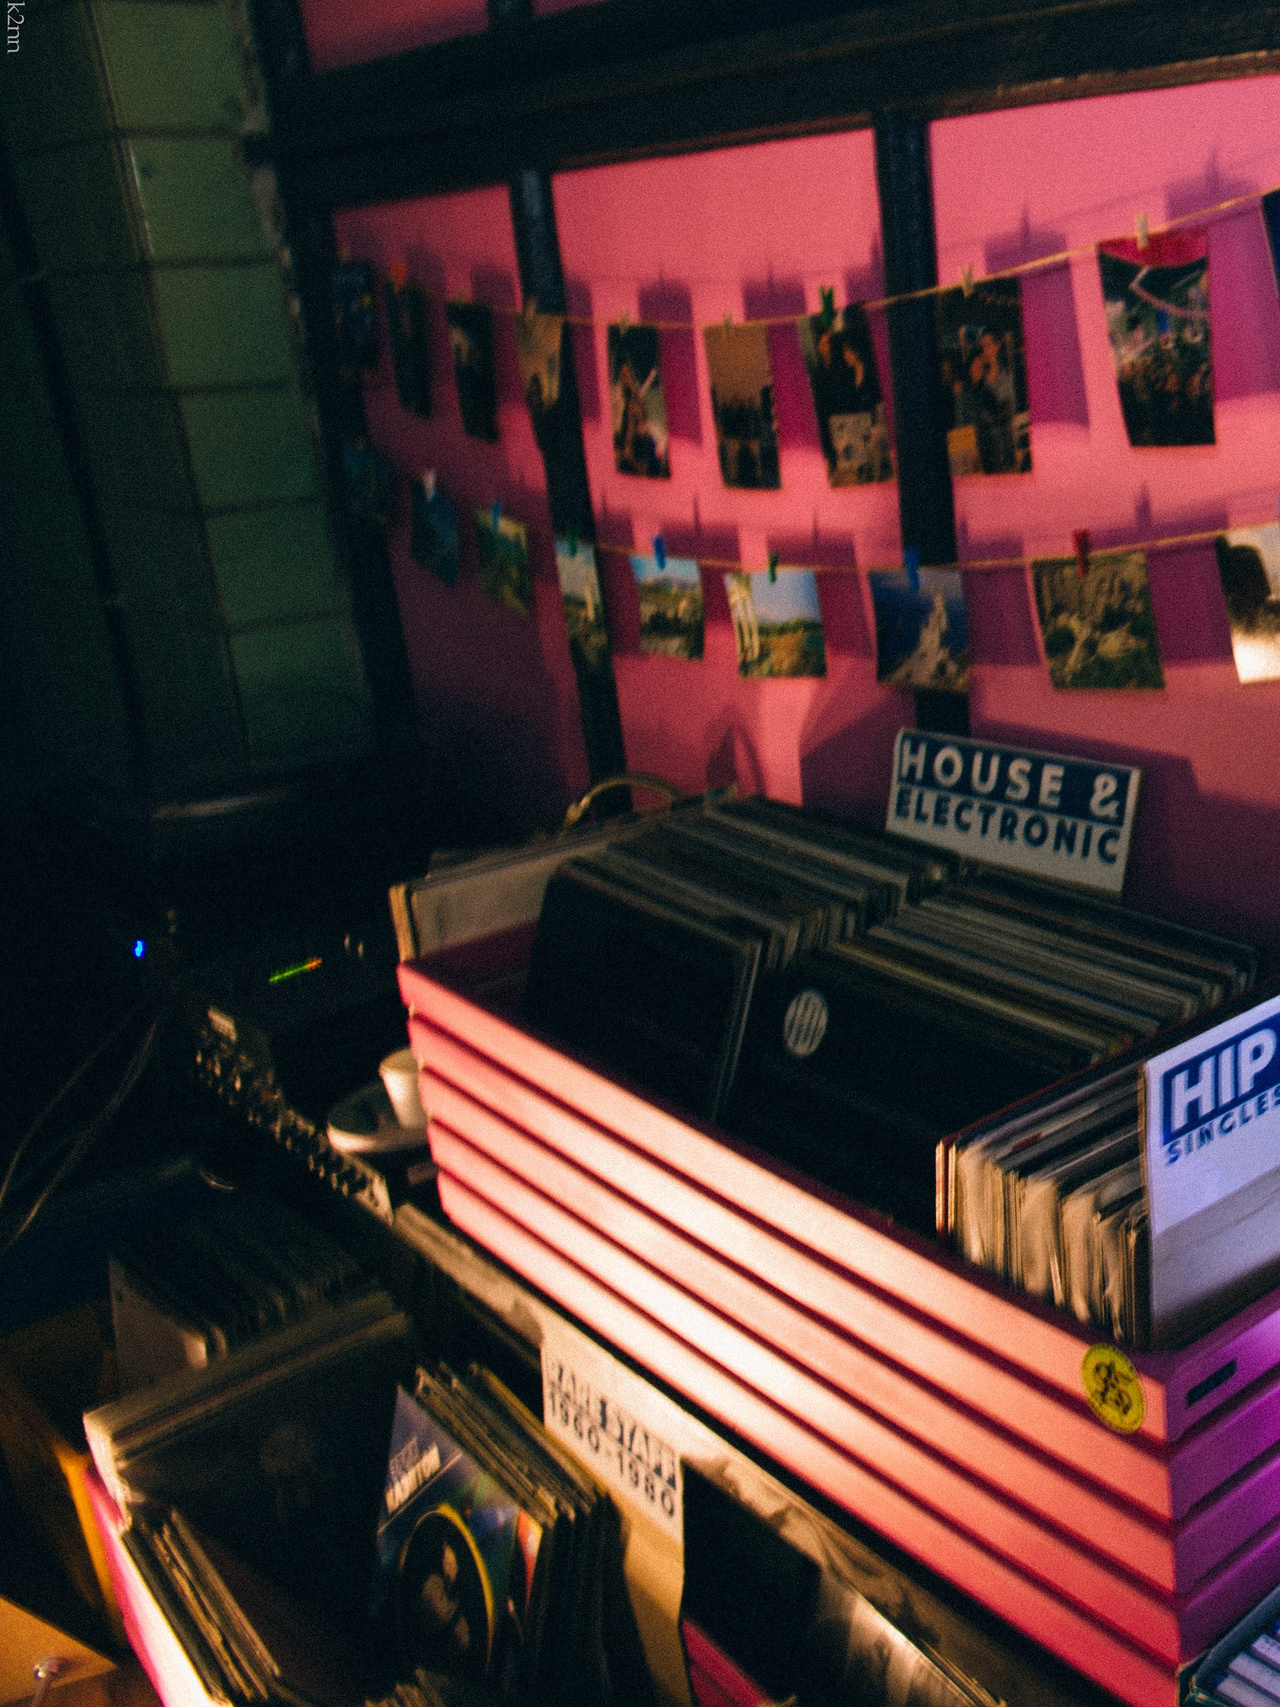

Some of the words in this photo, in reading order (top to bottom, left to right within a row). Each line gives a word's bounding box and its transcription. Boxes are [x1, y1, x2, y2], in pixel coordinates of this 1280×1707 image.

[900, 739, 1065, 808] HOUSE
[1090, 772, 1120, 820] &
[895, 787, 1120, 865] ELECTRONIC
[1171, 1028, 1278, 1134] HIP
